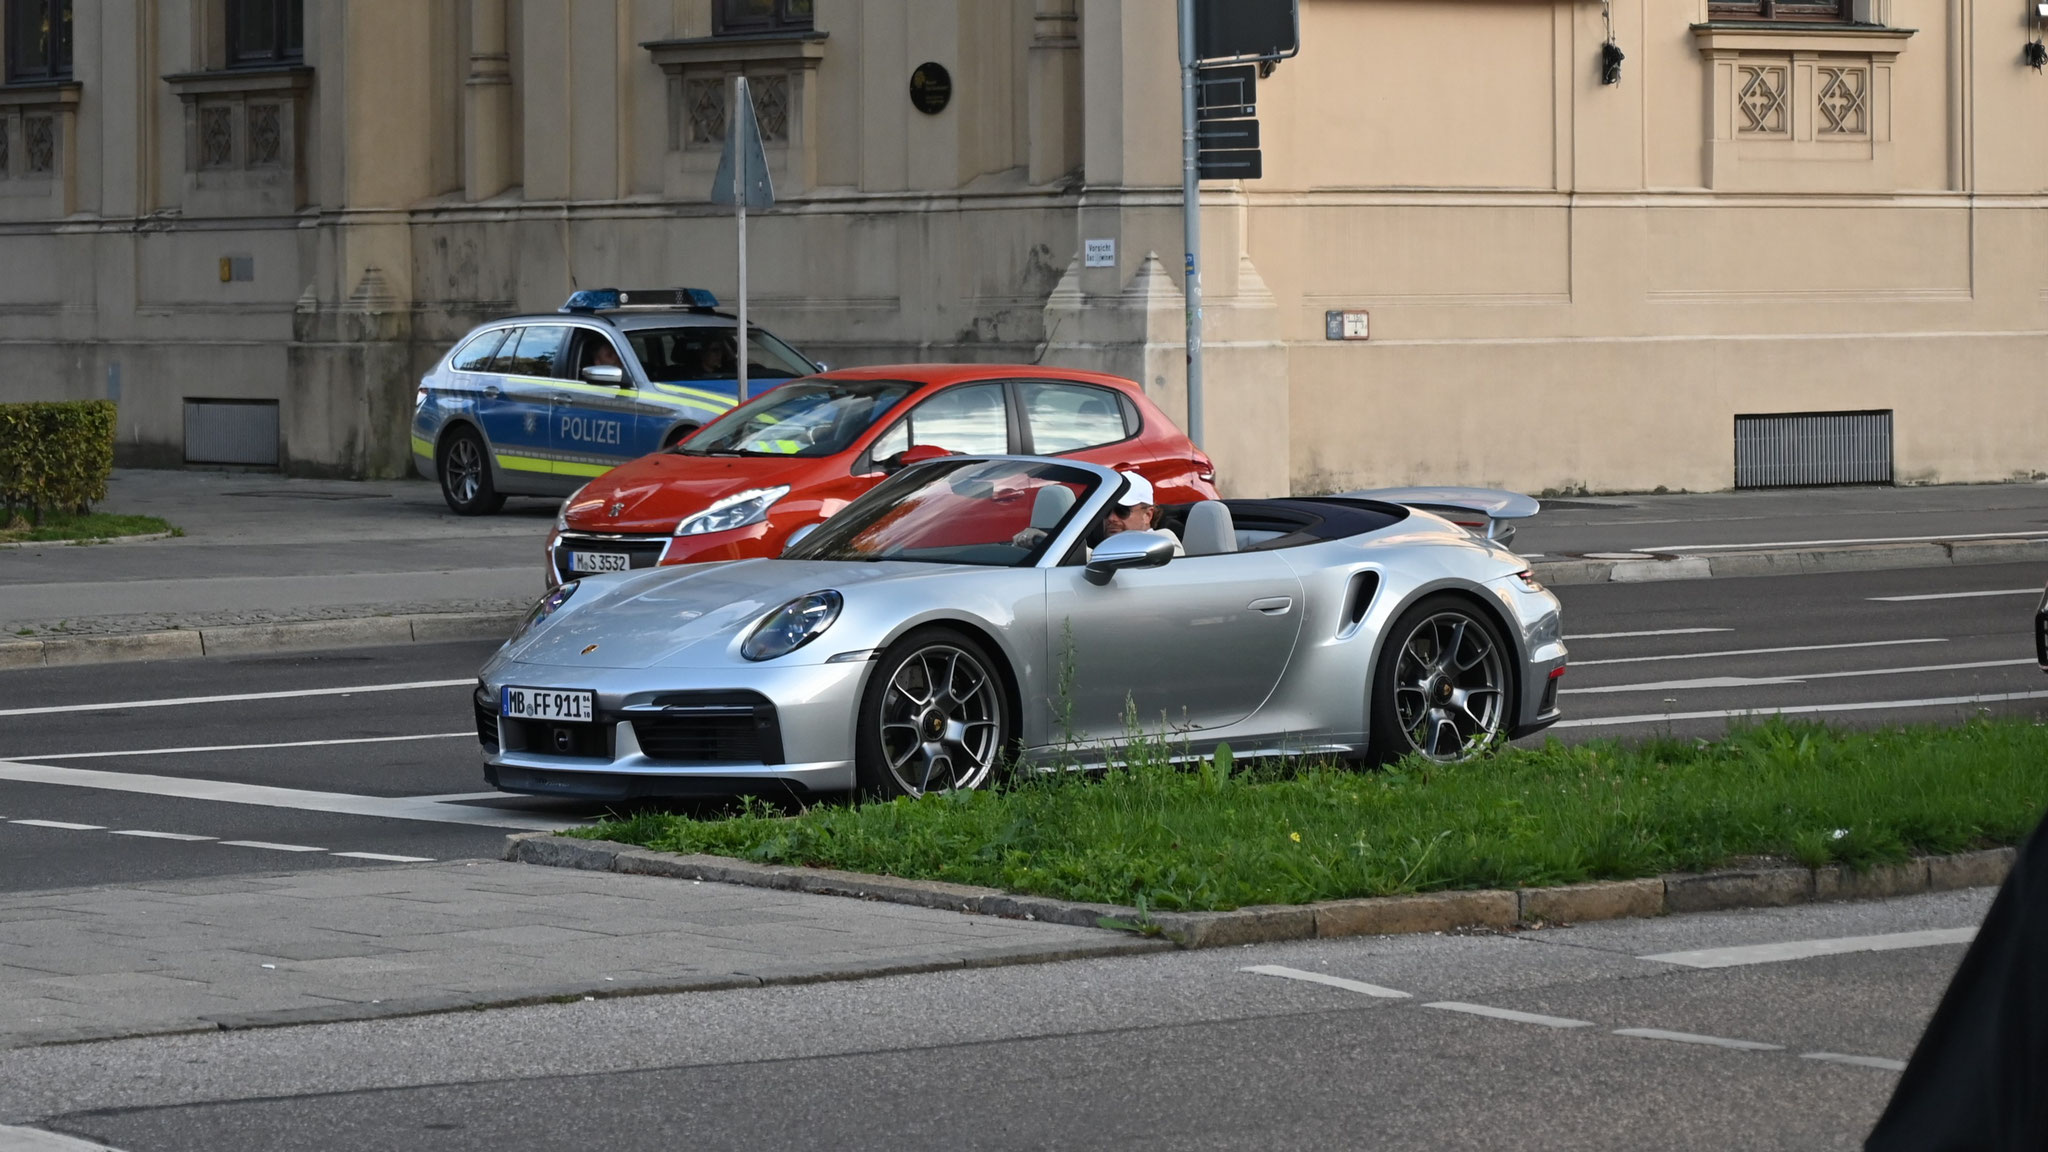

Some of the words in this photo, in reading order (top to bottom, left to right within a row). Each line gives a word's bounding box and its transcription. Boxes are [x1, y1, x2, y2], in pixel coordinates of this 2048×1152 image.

[1088, 244, 1111, 252] Vorsicht
[561, 416, 621, 445] POLIZEI
[598, 554, 626, 571] 3532
[509, 690, 525, 714] MB
[534, 693, 551, 716] FF
[554, 693, 582, 718] 911
